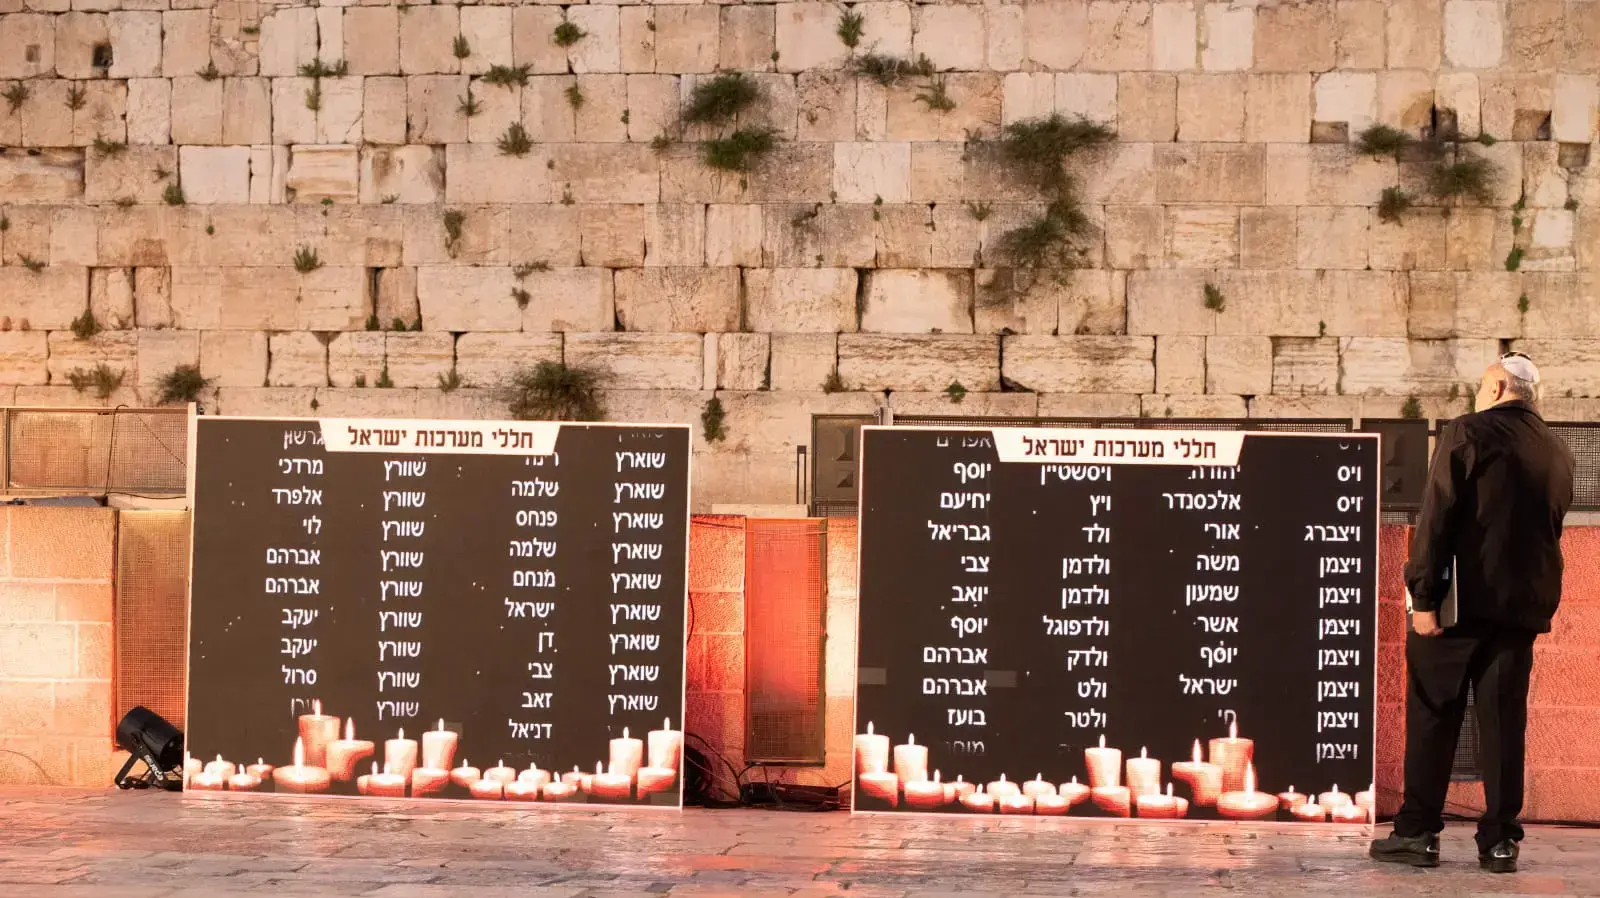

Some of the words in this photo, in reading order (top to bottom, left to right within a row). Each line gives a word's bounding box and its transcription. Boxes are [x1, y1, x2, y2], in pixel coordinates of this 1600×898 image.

[348, 425, 407, 446] ישראל
[415, 429, 483, 448] מערכות
[492, 428, 533, 448] חללי
[1023, 435, 1084, 456] ישראל
[1093, 439, 1164, 458] מערכות
[1174, 438, 1216, 459] חללי
[278, 458, 324, 474] מרדכי
[384, 460, 426, 481] שוורץ
[615, 452, 666, 473] שוארץ
[953, 463, 992, 484] יוסף
[1041, 465, 1112, 486] ויסשטיין
[1337, 465, 1361, 482] ויס
[271, 485, 322, 505] אלפרד
[512, 477, 559, 497] שלמה
[614, 483, 665, 504] שוארץ
[383, 491, 425, 511] שוורץ
[940, 493, 991, 509] יחיעם
[1090, 495, 1111, 516] ויץ
[1162, 490, 1241, 510] אלכסנדר
[1337, 496, 1361, 512] ויס
[303, 515, 321, 535] לוי
[516, 510, 558, 527] פנחס
[612, 512, 663, 534] שוארץ
[382, 521, 424, 541] שוורץ
[927, 520, 991, 541] גבריאל
[1081, 523, 1110, 544] ולד
[1205, 524, 1240, 540] אורי
[1304, 525, 1361, 541] ויצברג
[266, 548, 320, 565] אברהם
[509, 537, 556, 557] שלמה
[611, 543, 662, 564] שוארץ
[381, 550, 423, 571] שוורץ
[960, 556, 989, 572] צבי
[1062, 554, 1110, 579] ולדמן
[1197, 555, 1239, 571] משה
[1320, 557, 1361, 578] ויצמן
[265, 577, 319, 595] אברהם
[513, 570, 555, 587] מנחם
[610, 573, 661, 594] שוארץ
[380, 581, 422, 601] שוורץ
[952, 586, 988, 602] יואב
[1062, 585, 1109, 610] ולדמן
[1186, 585, 1239, 606] שמעון
[1320, 587, 1361, 608] ויצמן
[504, 597, 555, 618] ישראל
[609, 604, 661, 625] שוארץ
[281, 608, 318, 629] יעקב
[379, 611, 422, 632] שוורץ
[951, 616, 989, 638] יוסף
[1043, 615, 1109, 636] ולדפוגל
[1197, 616, 1239, 633] אשר
[1319, 619, 1360, 640] ויצמן
[280, 638, 317, 658] יעקב
[378, 641, 421, 661] שוורץ
[538, 632, 554, 653] דן
[609, 634, 660, 654] שוארץ
[923, 647, 987, 664] אברהם
[1067, 646, 1108, 671] ולדק
[1201, 647, 1237, 668] יוסף
[1318, 649, 1360, 671] ויצמן
[281, 665, 317, 685] סרול
[528, 663, 554, 679] צבי
[608, 665, 659, 685] שוארץ
[378, 672, 420, 692] שוורץ
[922, 678, 987, 695] אברהם
[1078, 677, 1108, 698] ולט
[1179, 674, 1237, 695] ישראל
[1318, 681, 1360, 702] ויצמן
[521, 692, 554, 708] זאב
[607, 695, 658, 715] שוארץ
[376, 701, 420, 721] שוורץ
[947, 708, 987, 726] בועז
[1064, 708, 1107, 728] ולטר
[508, 719, 553, 739] דניאל
[1318, 712, 1359, 732] ויצמן
[1316, 743, 1358, 763] ויצמן
